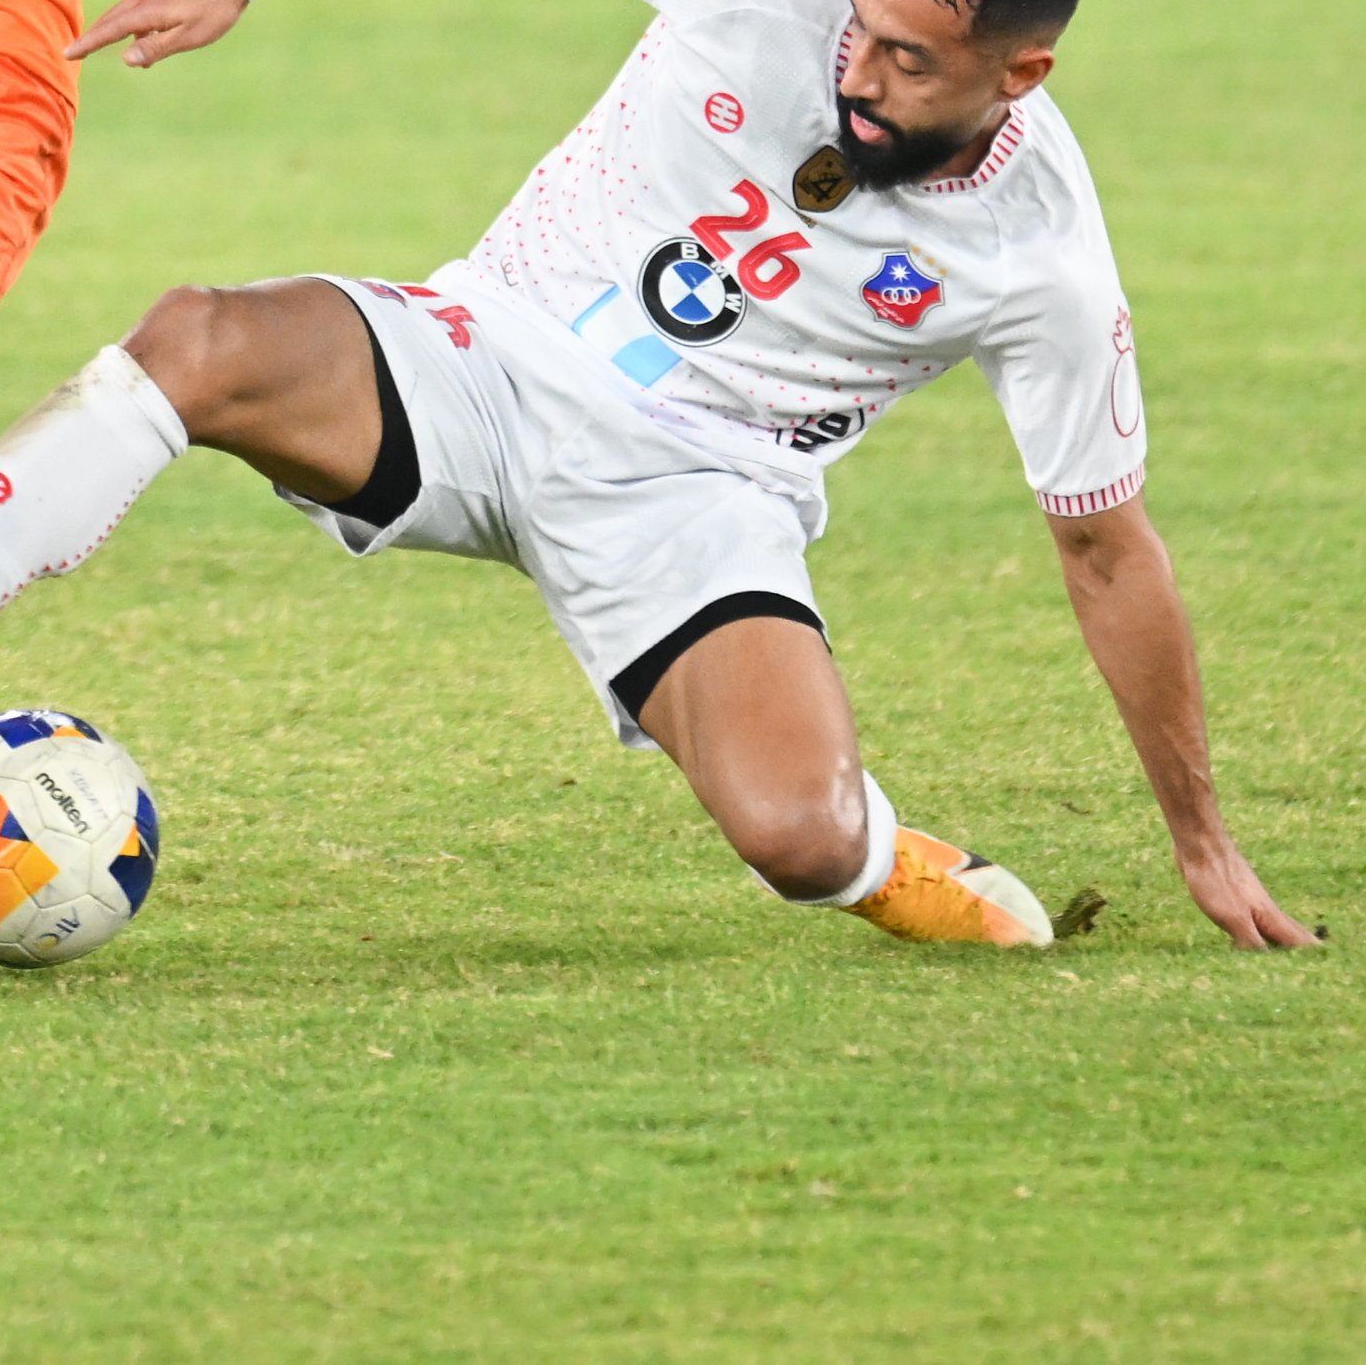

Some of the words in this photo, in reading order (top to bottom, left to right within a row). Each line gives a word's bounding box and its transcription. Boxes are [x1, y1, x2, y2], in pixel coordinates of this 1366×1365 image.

[689, 179, 812, 301] 26
[680, 242, 742, 314] BMW
[35, 772, 89, 834] molten
